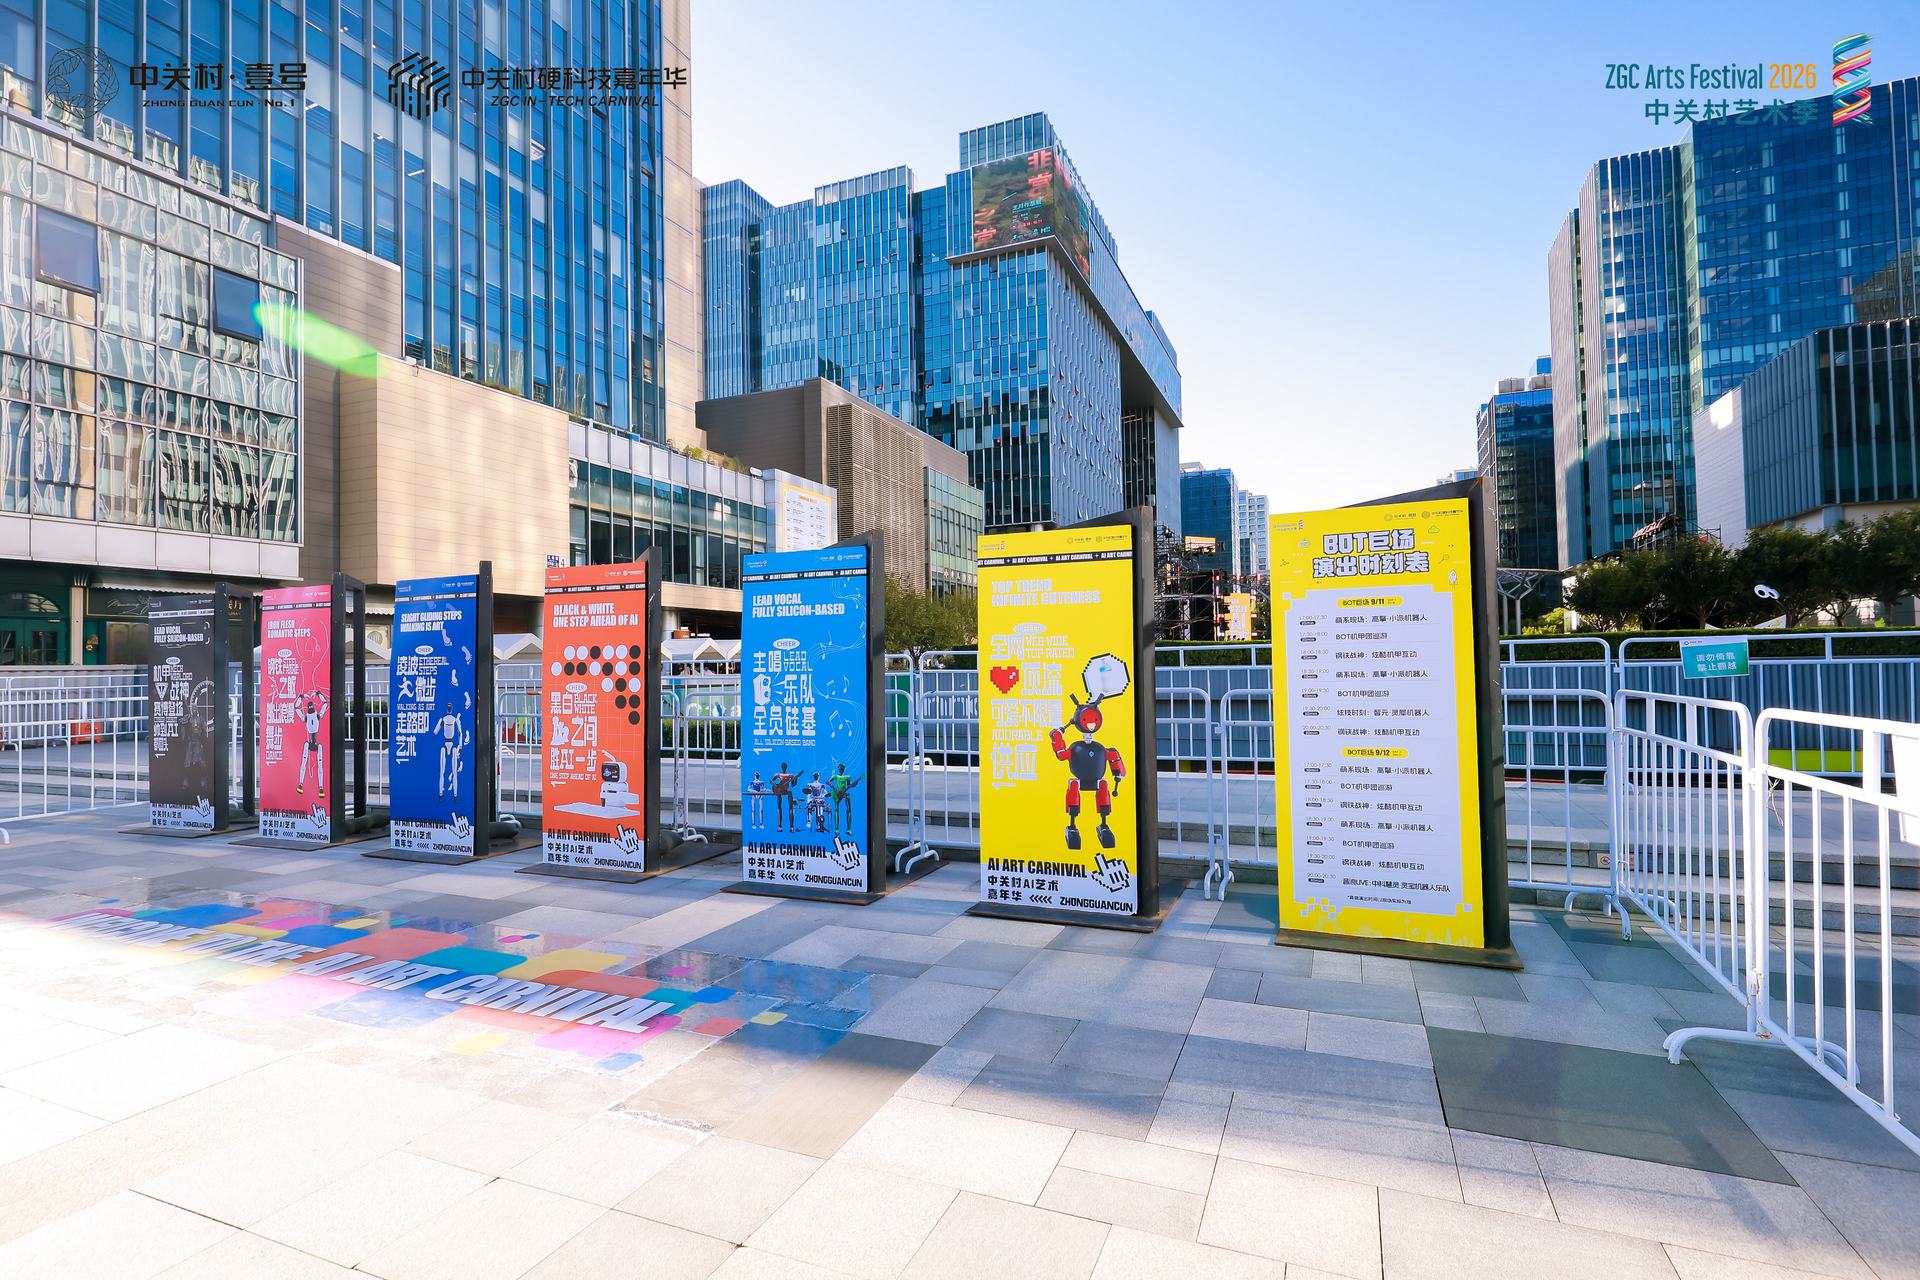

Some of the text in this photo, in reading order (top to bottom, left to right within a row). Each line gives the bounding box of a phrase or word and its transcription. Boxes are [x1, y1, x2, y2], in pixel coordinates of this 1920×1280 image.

[1323, 528, 1416, 555] BOT巨场
[1312, 551, 1430, 579] 演出时刻表
[753, 593, 802, 606] LEAD VOCAL
[1371, 598, 1385, 606] 9/11
[443, 610, 462, 621] STEPS
[554, 603, 614, 616] BLACK & WHITE
[753, 604, 845, 618] FULLY SILICON-BASED
[553, 614, 638, 628] ONE STEP AHEAD OF AI
[753, 650, 782, 672] 主唱
[784, 650, 806, 661] LEAD
[784, 661, 813, 672] VOCAL
[1021, 661, 1062, 697] 顶流
[783, 674, 815, 704] 乐队
[753, 706, 816, 736] 全员硅基
[571, 716, 597, 747] 之间
[1375, 748, 1390, 756] 9/12
[990, 742, 1038, 781] 供应
[548, 828, 612, 844] AI ART CARNIVAL
[748, 842, 827, 858] AI ART CARNIVAL
[594, 858, 641, 869] ZHONGGUANCUN
[748, 857, 805, 871] 中关村AI艺术
[988, 858, 1087, 878] AI ART CARNIVAL
[805, 874, 862, 887] ZHONGGUANCUN
[988, 875, 1059, 891] 中关村AI艺术
[988, 889, 1023, 901] 嘉年华
[1060, 896, 1133, 912] ZHONGGUANCUN
[216, 939, 328, 968] THE
[281, 951, 376, 977] AI
[329, 959, 458, 991] ART
[425, 974, 675, 1034] CARNIVAL
